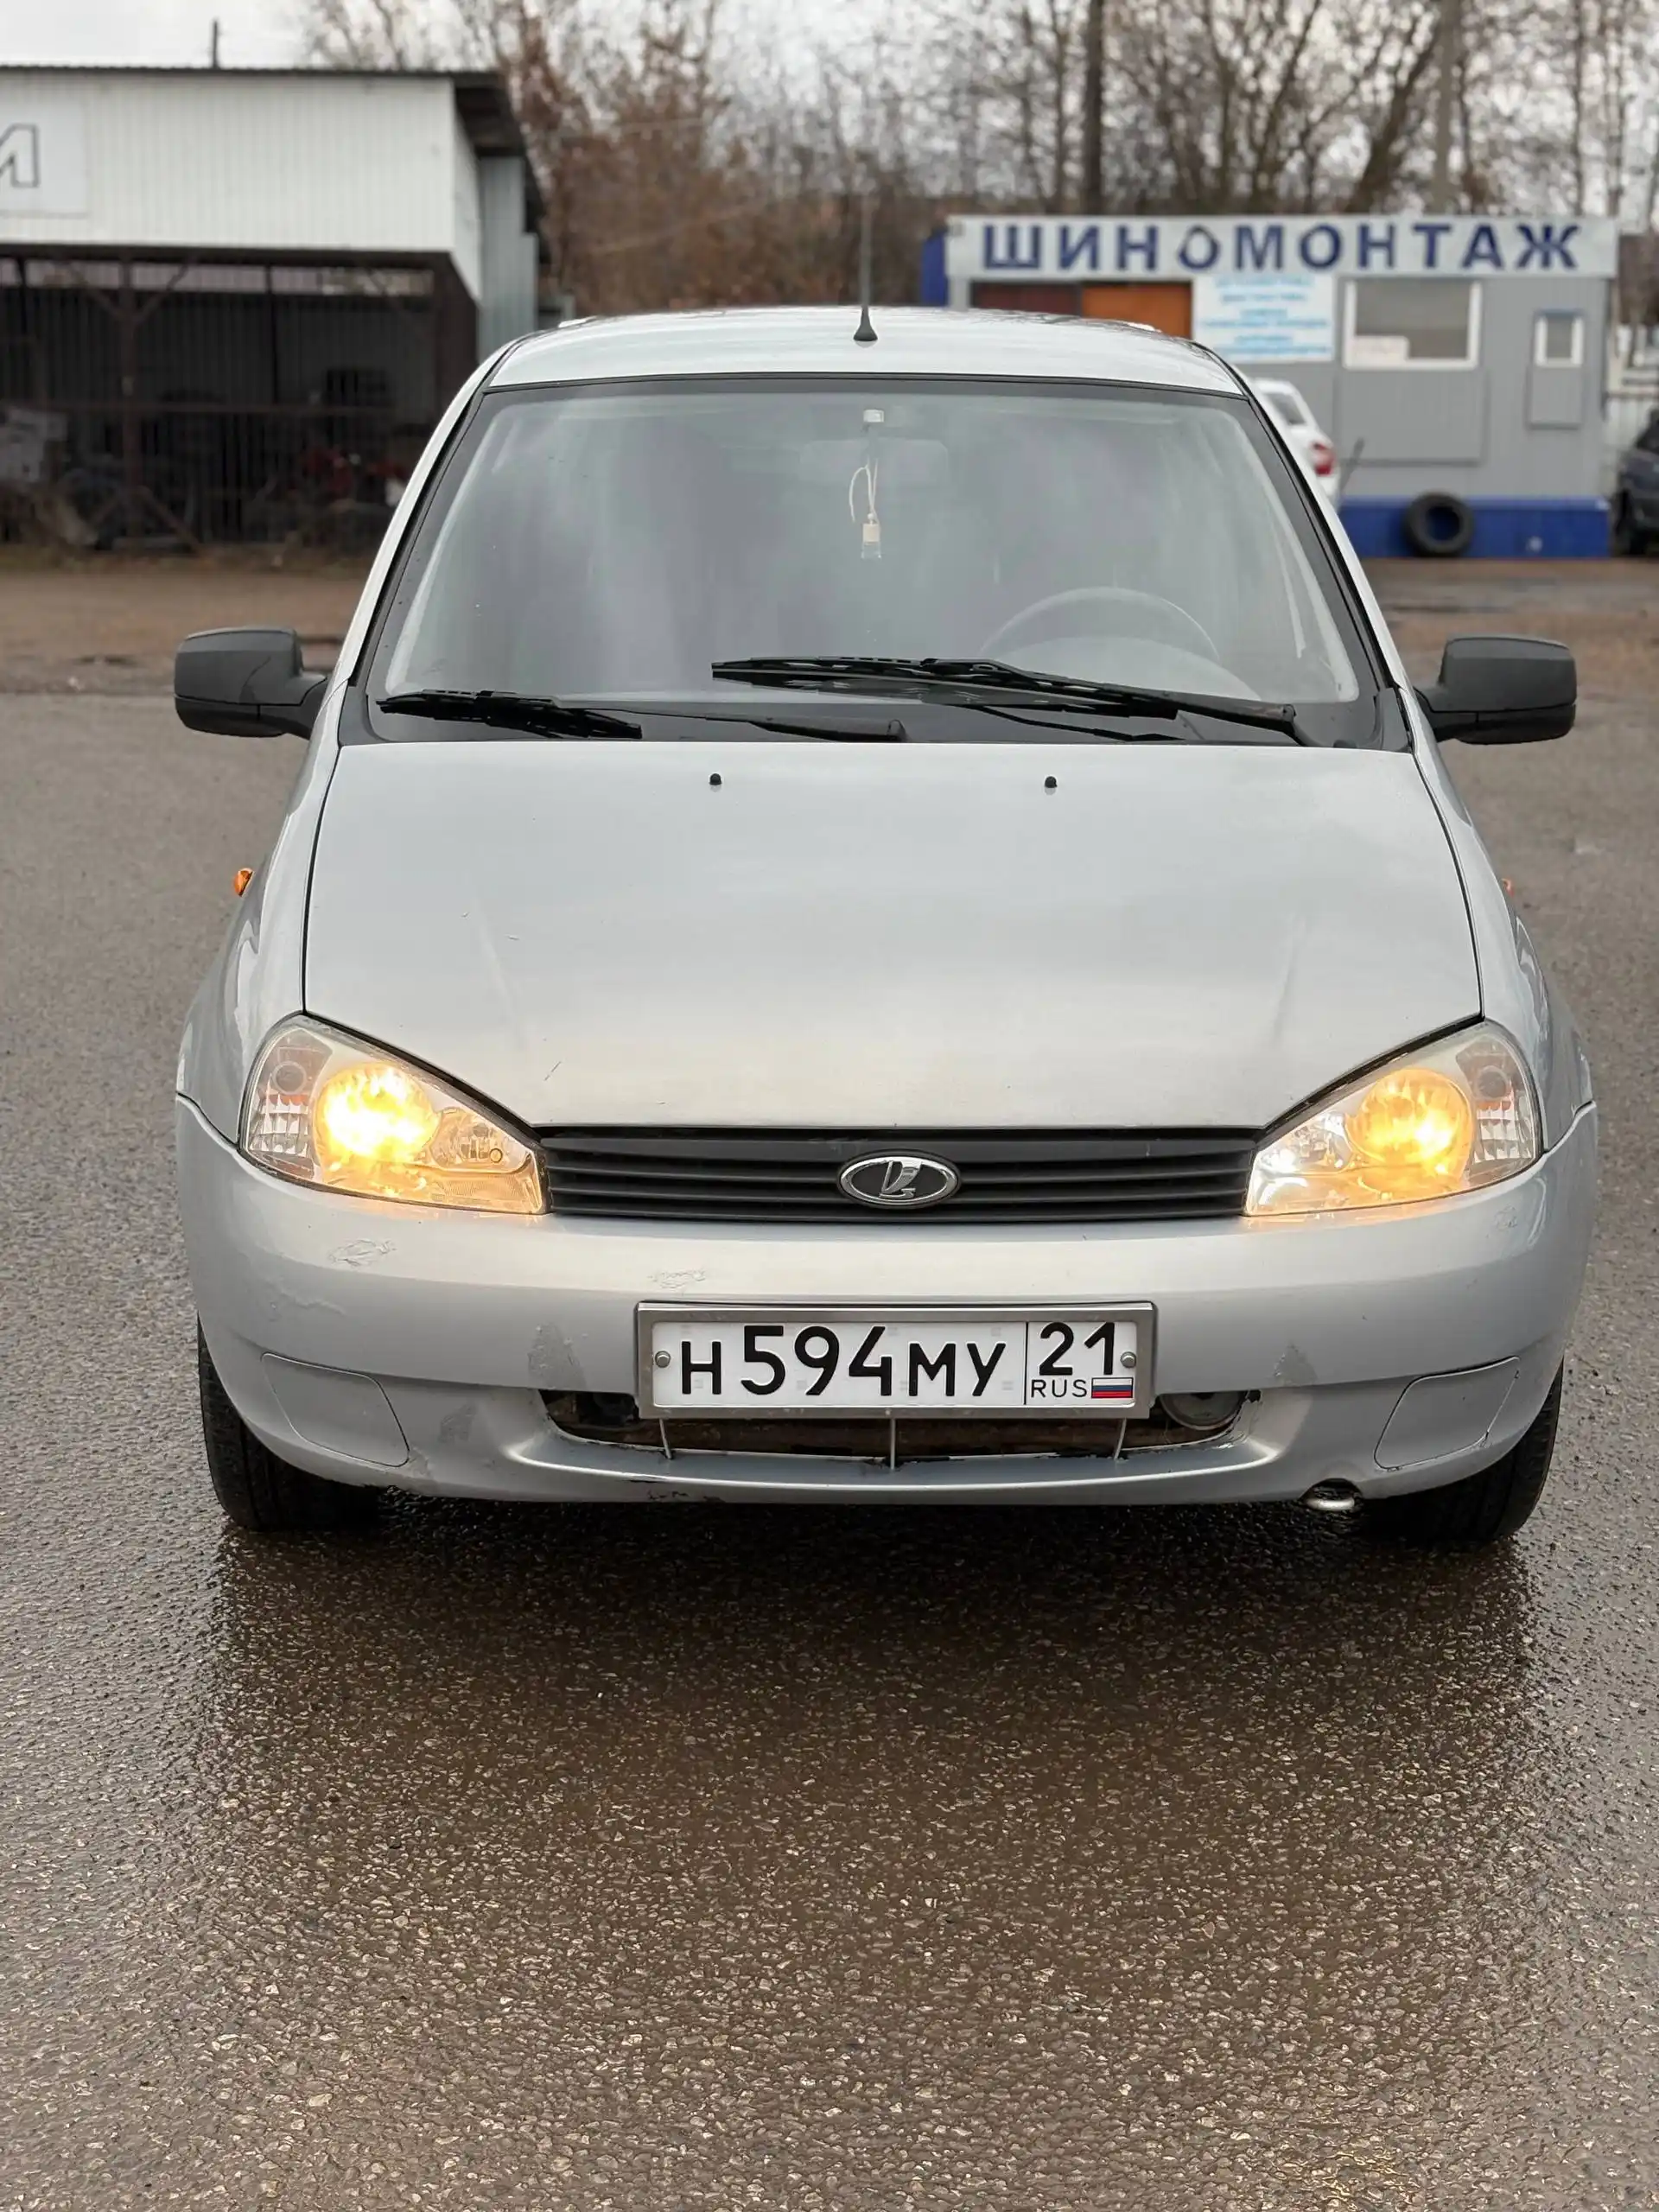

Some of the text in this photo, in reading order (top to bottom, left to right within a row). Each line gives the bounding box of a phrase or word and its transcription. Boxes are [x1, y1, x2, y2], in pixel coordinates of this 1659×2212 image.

[982, 222, 1580, 271] ШИНОМОНТАЖ
[681, 1321, 1116, 1396] Н594МУ 21
[1030, 1379, 1088, 1398] RUS
